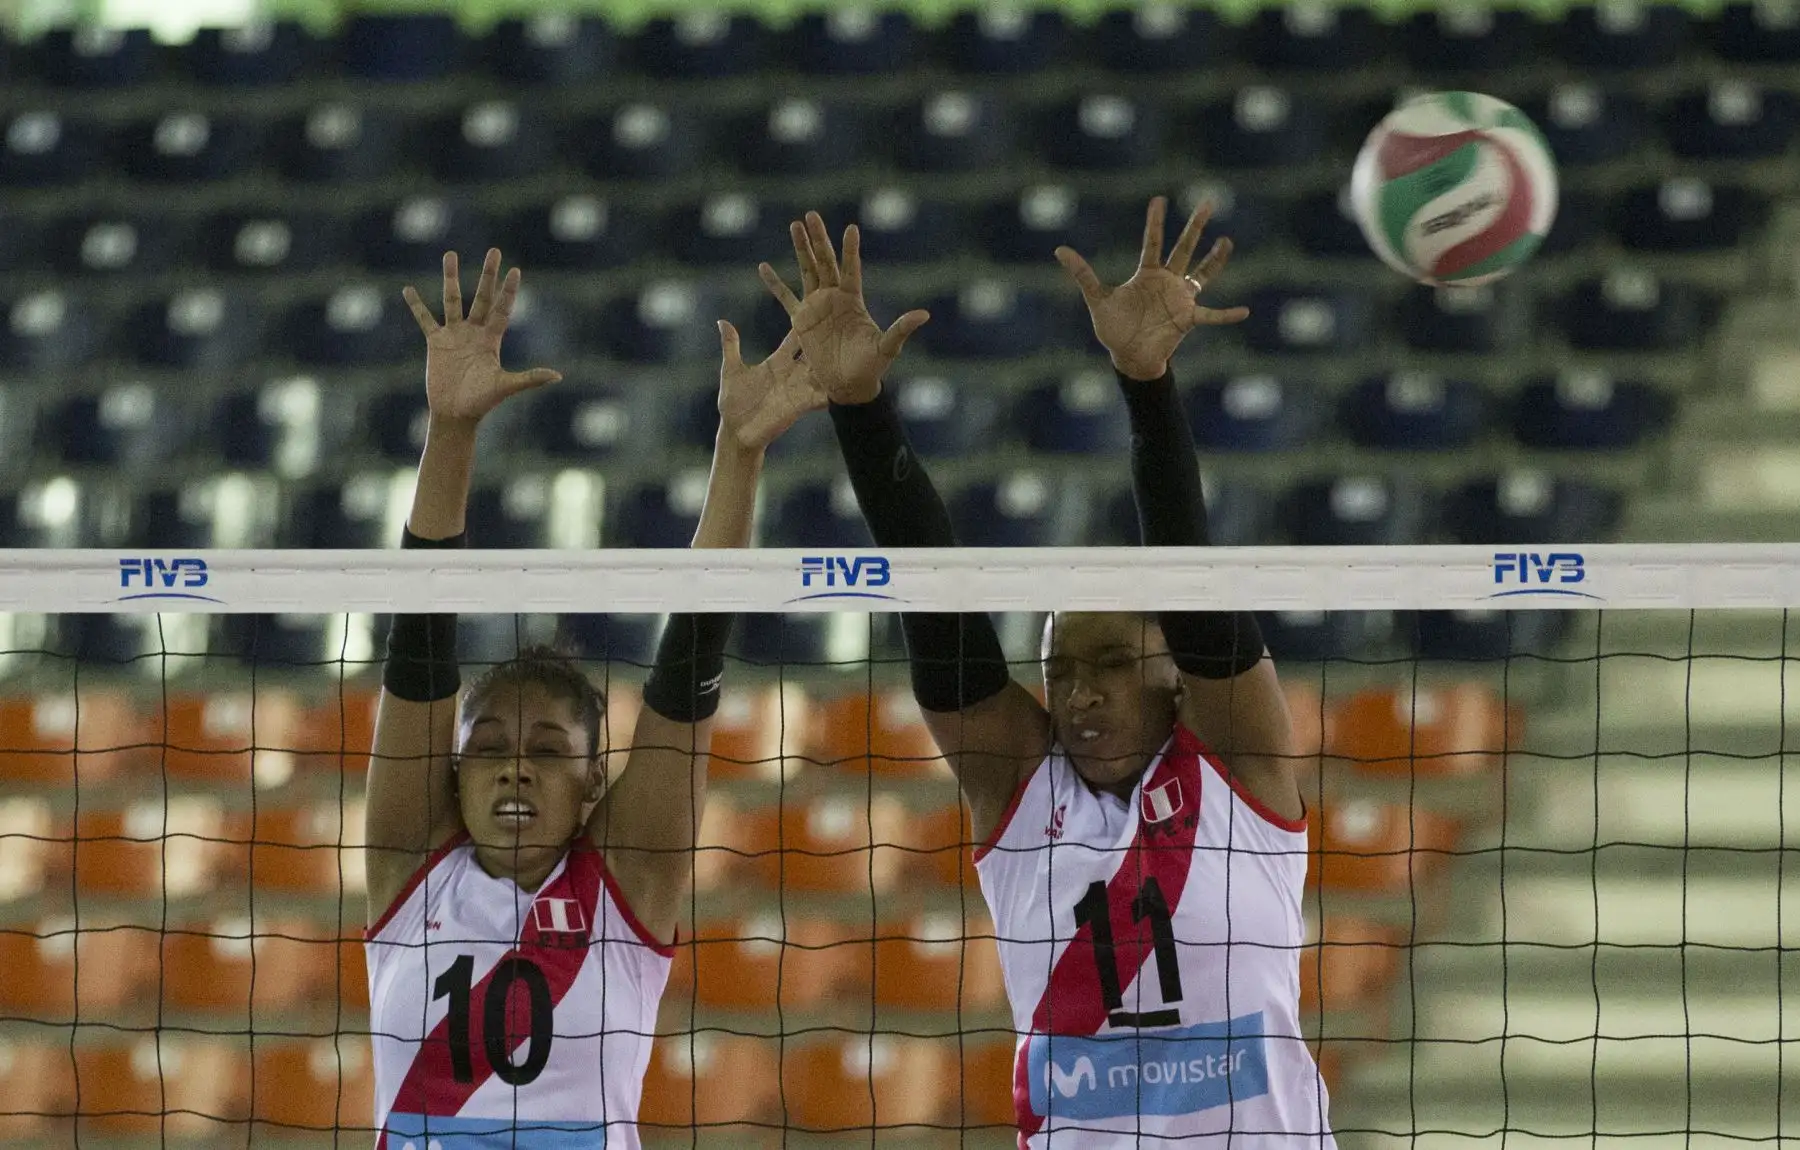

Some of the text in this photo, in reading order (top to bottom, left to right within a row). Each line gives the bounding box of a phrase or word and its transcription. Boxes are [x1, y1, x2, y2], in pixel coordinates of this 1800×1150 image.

[119, 558, 208, 587] FIVB
[801, 556, 891, 586] FIVB
[1494, 553, 1585, 583] FIVB
[1073, 876, 1184, 1010] 11
[432, 954, 553, 1086] 10
[1107, 1049, 1246, 1089] movistar
